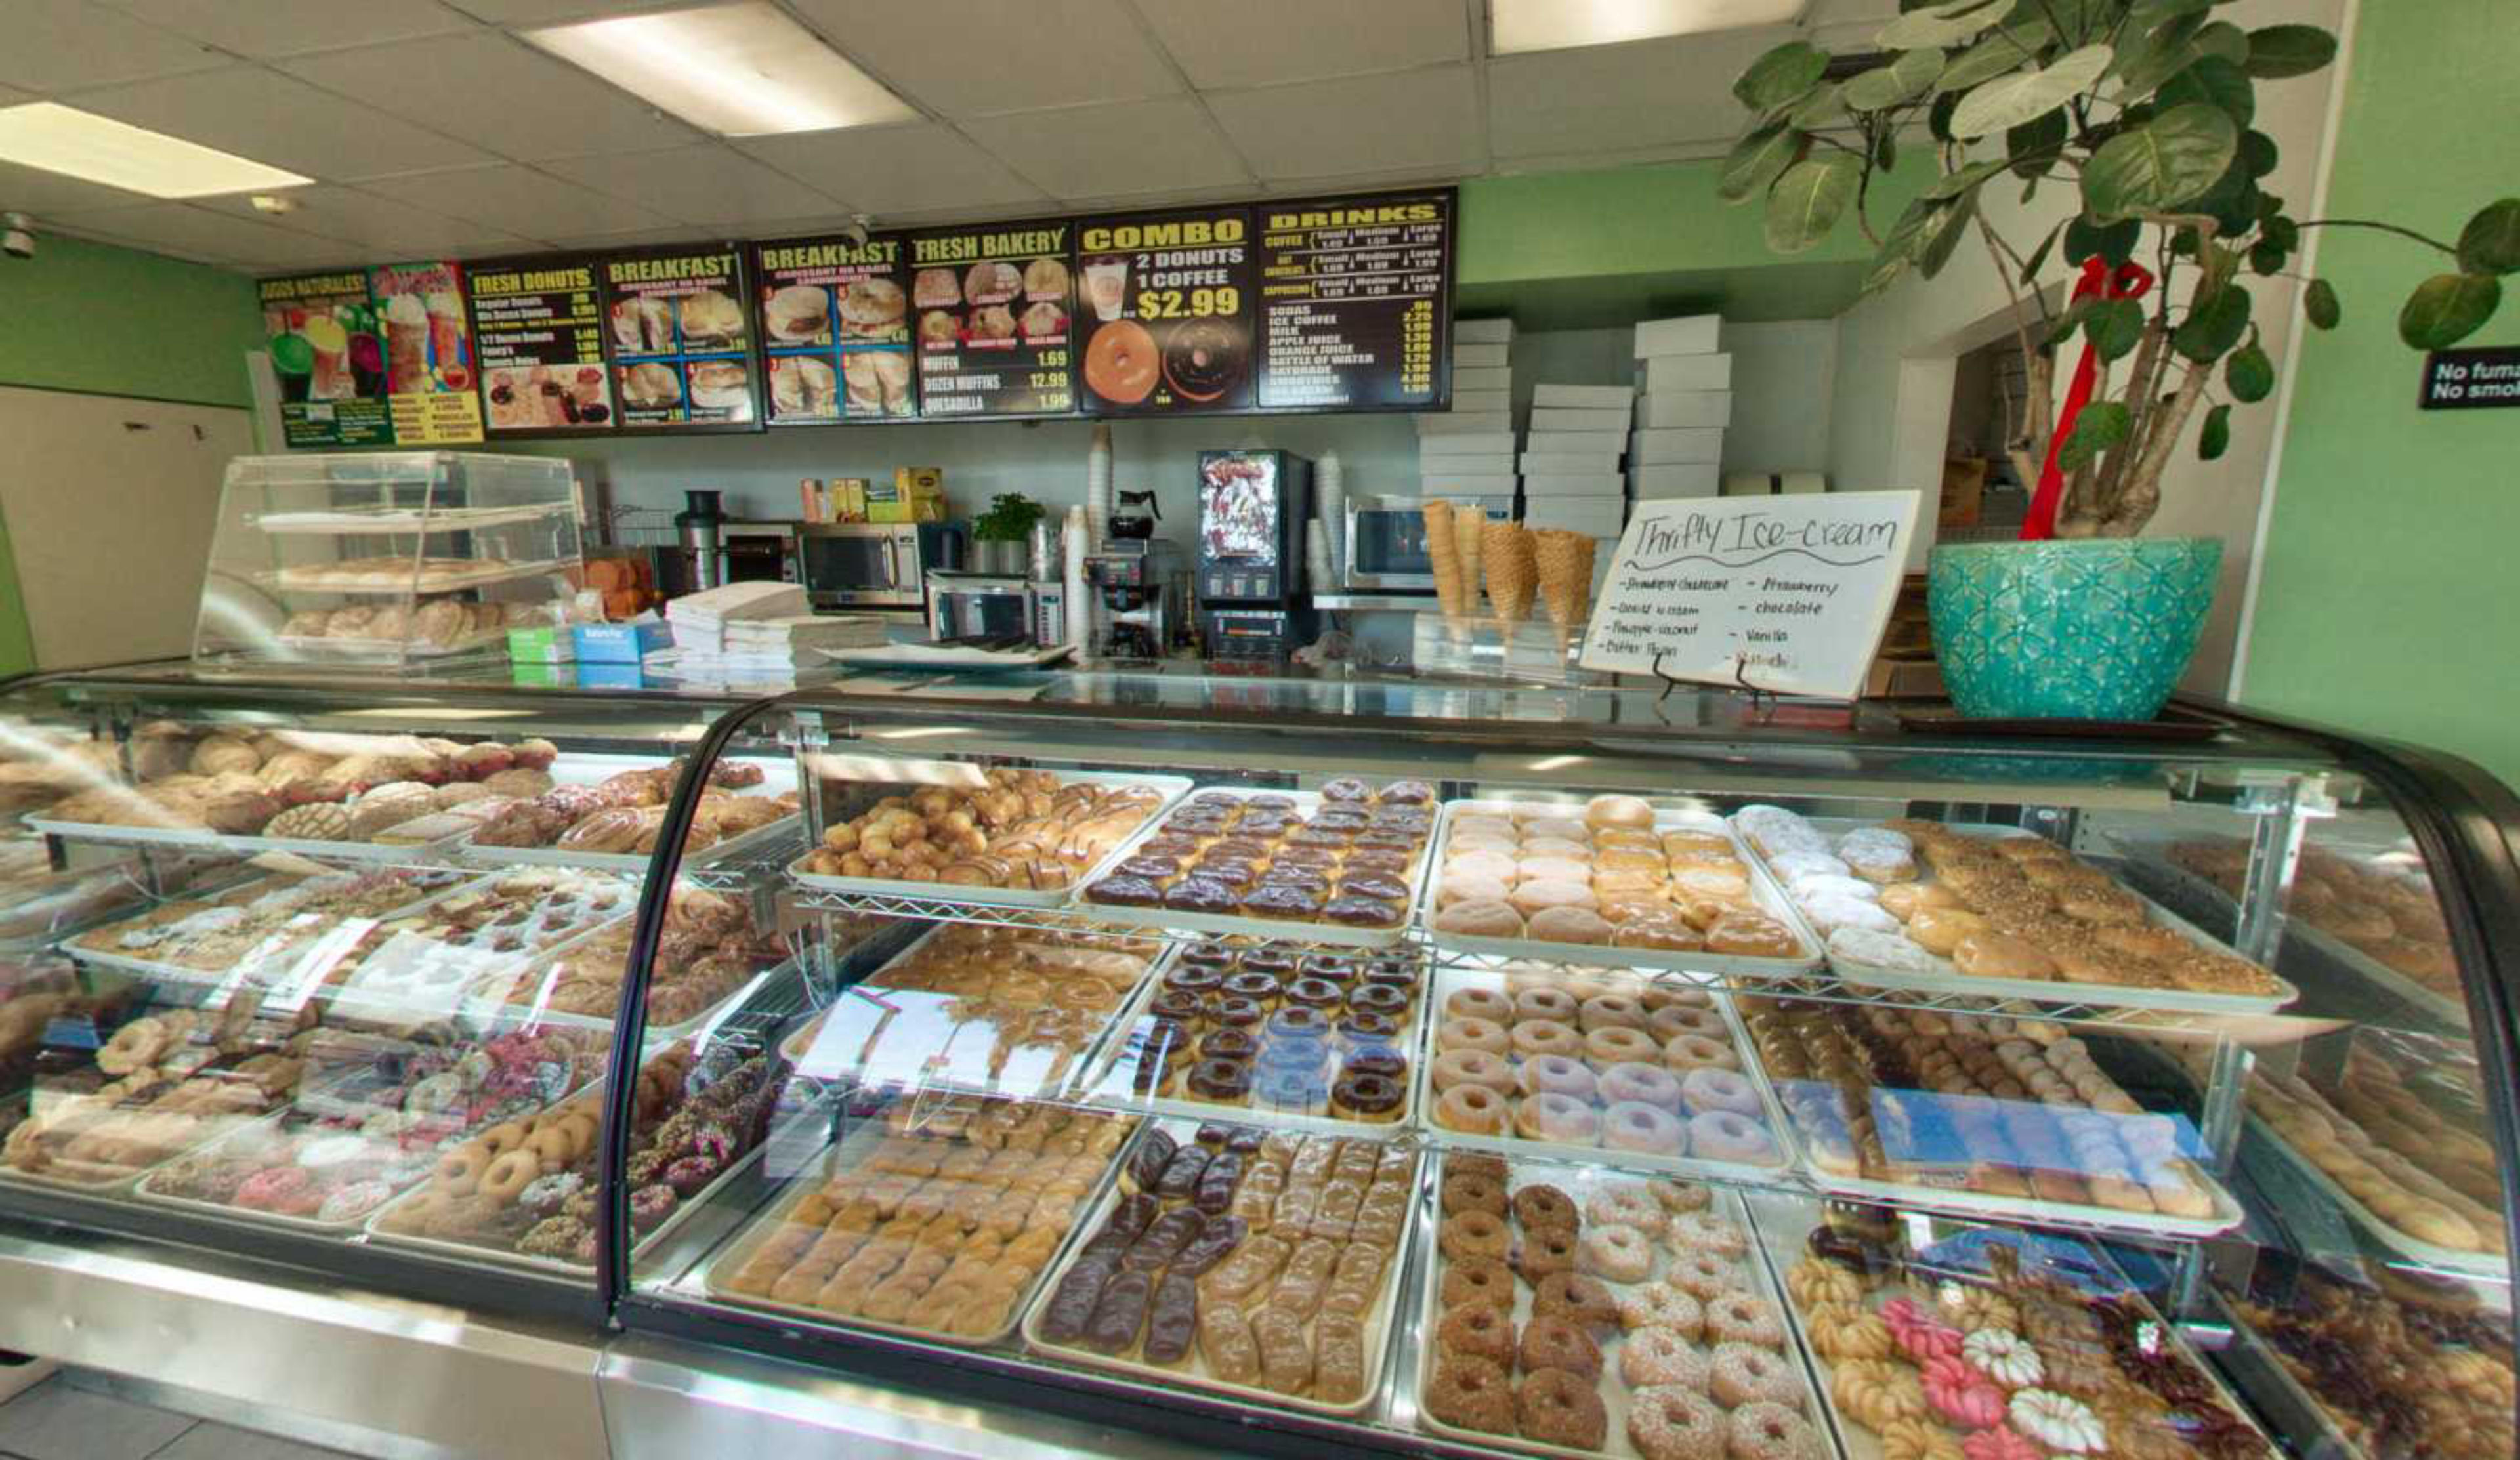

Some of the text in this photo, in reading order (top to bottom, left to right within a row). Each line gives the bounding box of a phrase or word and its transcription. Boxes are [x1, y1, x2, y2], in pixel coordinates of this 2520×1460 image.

[1270, 205, 1435, 228] DRINKS
[1083, 219, 1244, 251] COMBO
[915, 229, 1062, 261] FRESH BAKERY
[763, 241, 898, 270] BREAKFAST
[1136, 248, 1244, 268] 2 DONUTS
[610, 254, 733, 283] BREAKFAST
[474, 273, 521, 293] FRESH
[523, 268, 591, 290] DONUTS
[1137, 269, 1228, 289] 1 COFFEE
[1138, 287, 1239, 320] $2.99
[1269, 306, 1311, 315] SODAS
[1269, 316, 1288, 325] ICE
[1293, 315, 1337, 325] COFFEE
[1269, 326, 1299, 335] MILK
[1269, 336, 1305, 345] APPLE
[1308, 335, 1341, 344] JUICE
[1037, 350, 1067, 367] 1.69
[1269, 346, 1317, 355] ORANGE
[1320, 344, 1354, 353] JUICE
[1314, 355, 1328, 364] OF
[1331, 354, 1374, 364] WATER
[1029, 371, 1068, 388] 12.99
[2437, 363, 2468, 379] No
[2433, 381, 2520, 399] No smo
[1635, 513, 1723, 556] Thrifty
